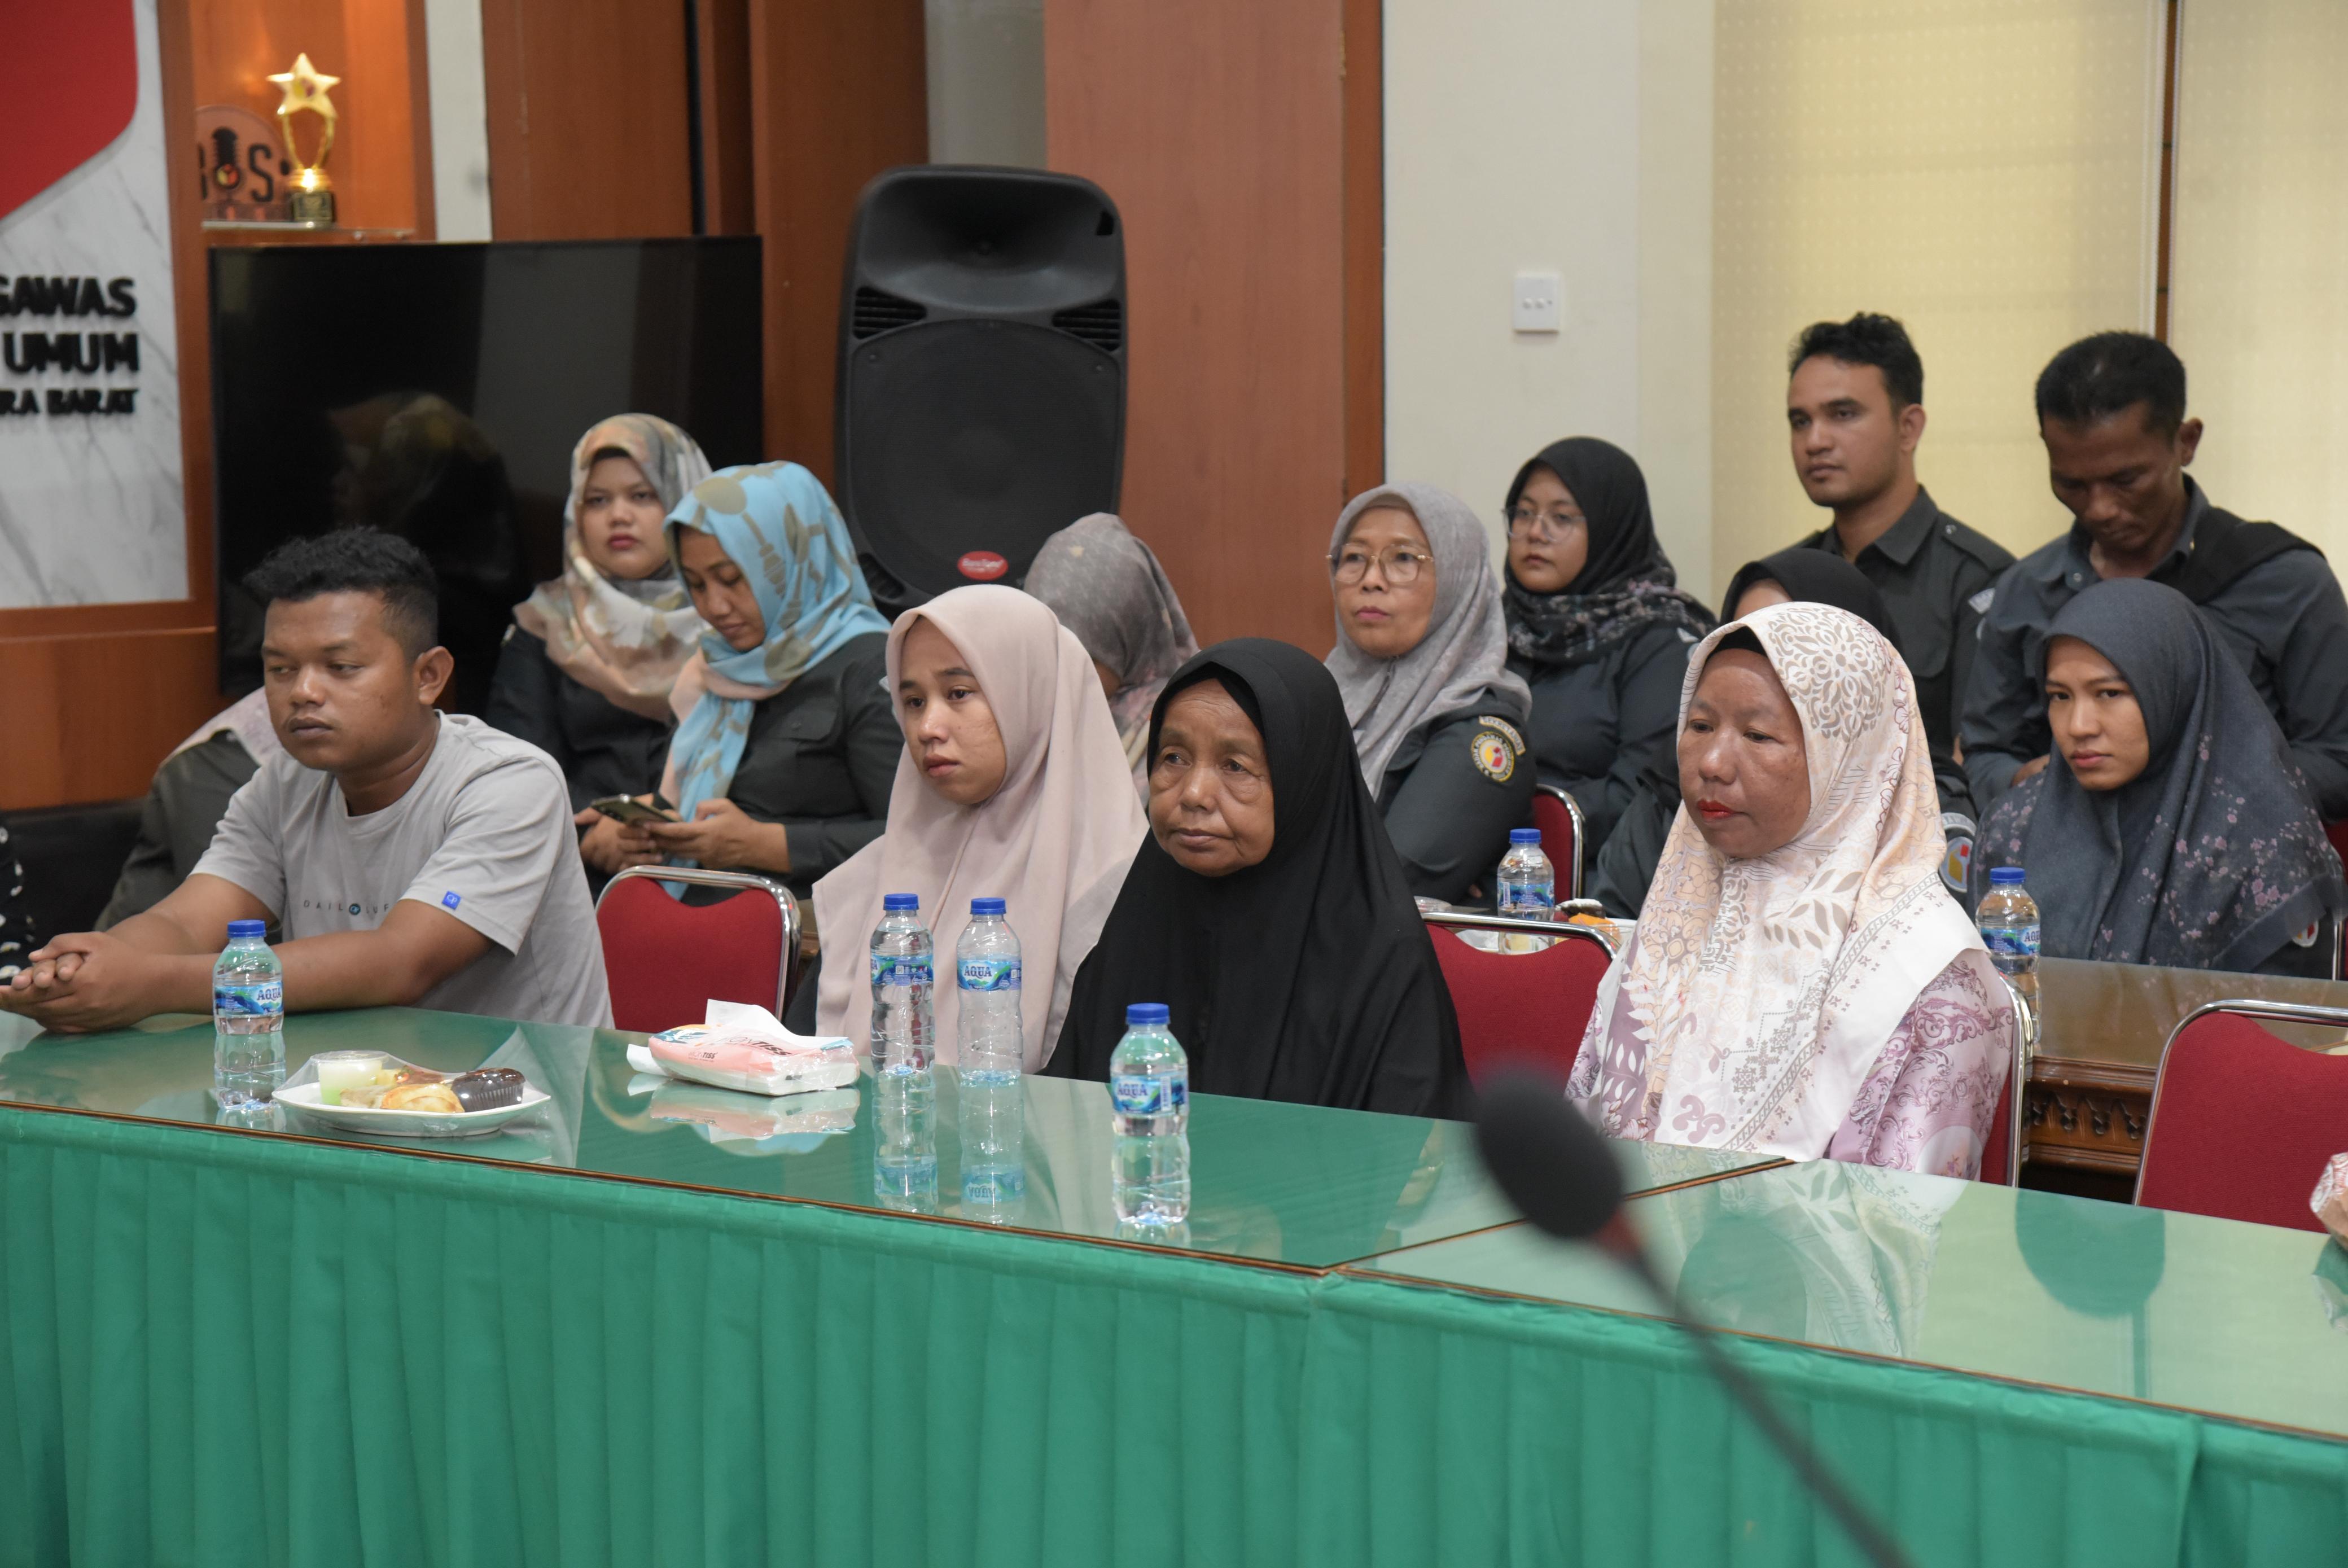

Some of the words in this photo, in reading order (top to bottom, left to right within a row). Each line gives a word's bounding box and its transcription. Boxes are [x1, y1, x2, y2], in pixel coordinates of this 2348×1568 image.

[3, 332, 139, 373] UMUM
[47, 388, 139, 415] BARAT
[965, 966, 992, 979] AQUA
[257, 987, 281, 1001] AQUA
[1118, 1083, 1147, 1098] AQUA
